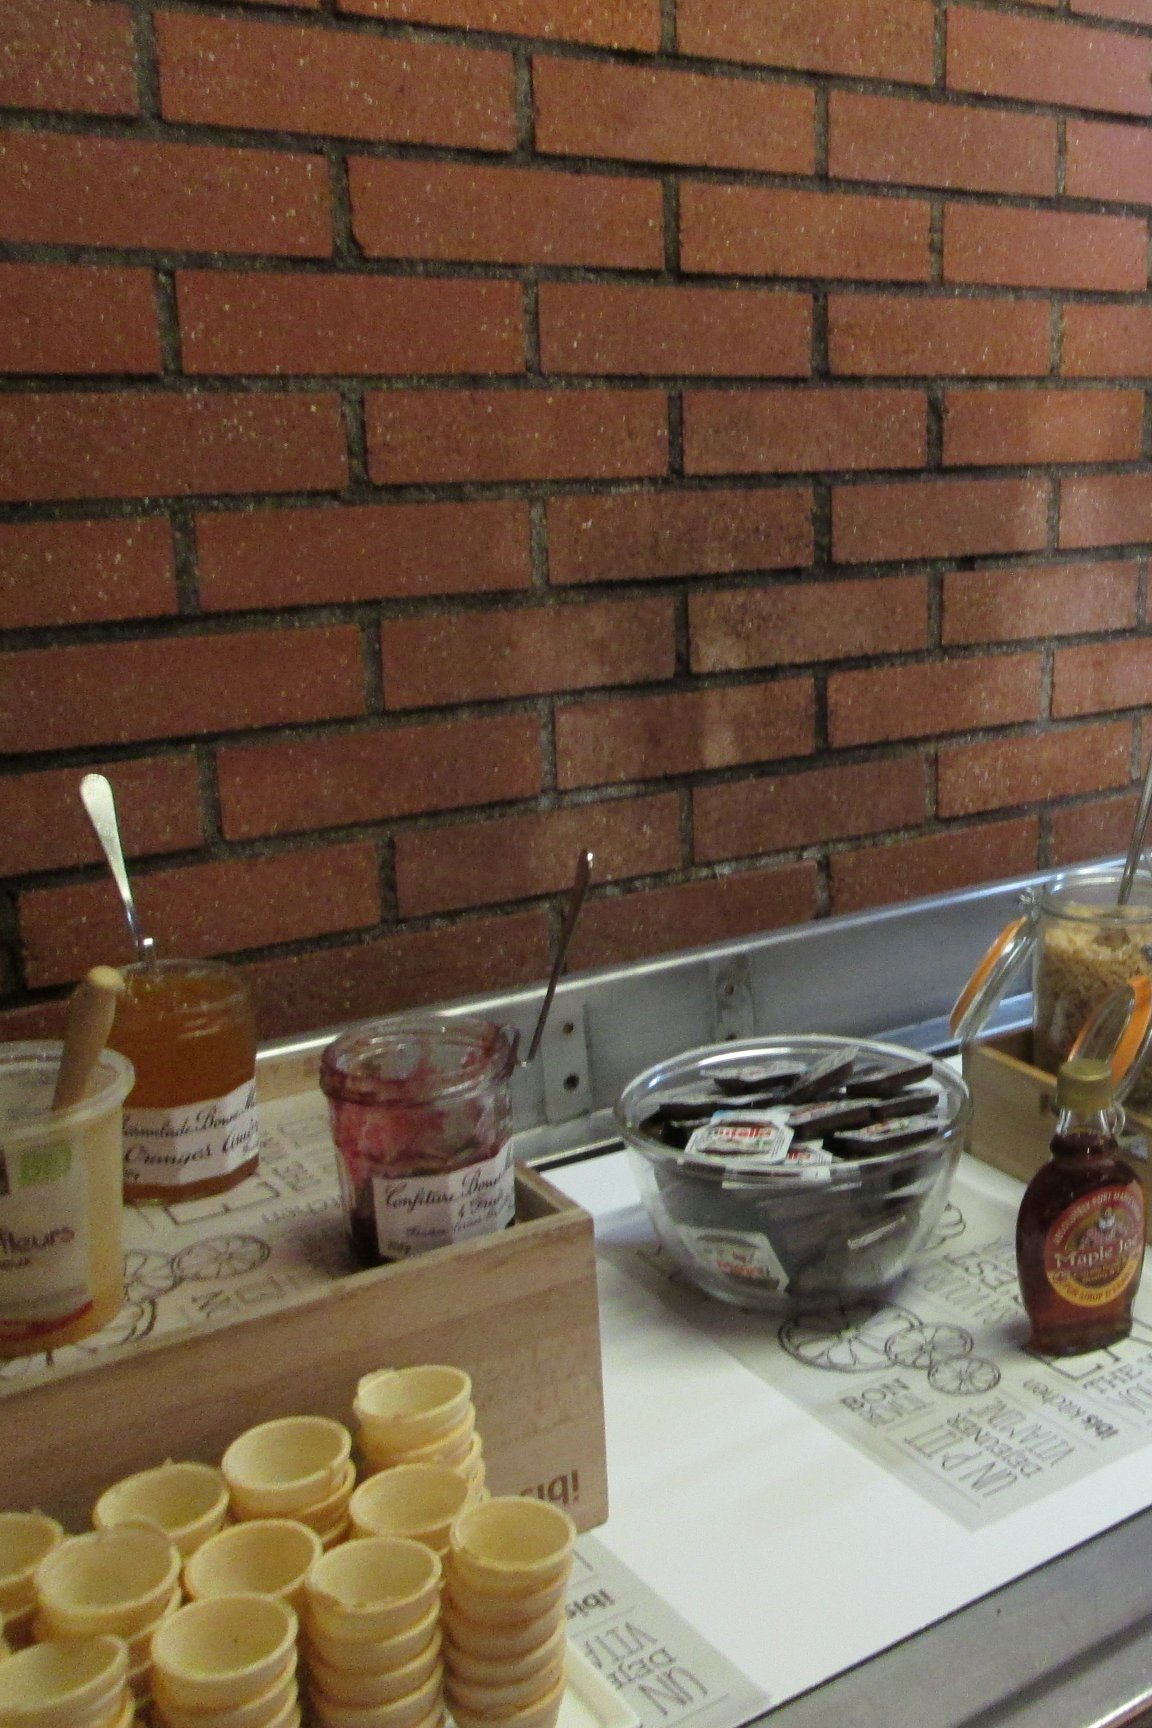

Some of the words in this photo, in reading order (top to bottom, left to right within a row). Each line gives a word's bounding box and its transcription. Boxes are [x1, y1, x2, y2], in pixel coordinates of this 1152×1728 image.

[385, 1183, 455, 1213] Confiture
[1053, 1246, 1114, 1269] Maple
[637, 1665, 709, 1716] UN
